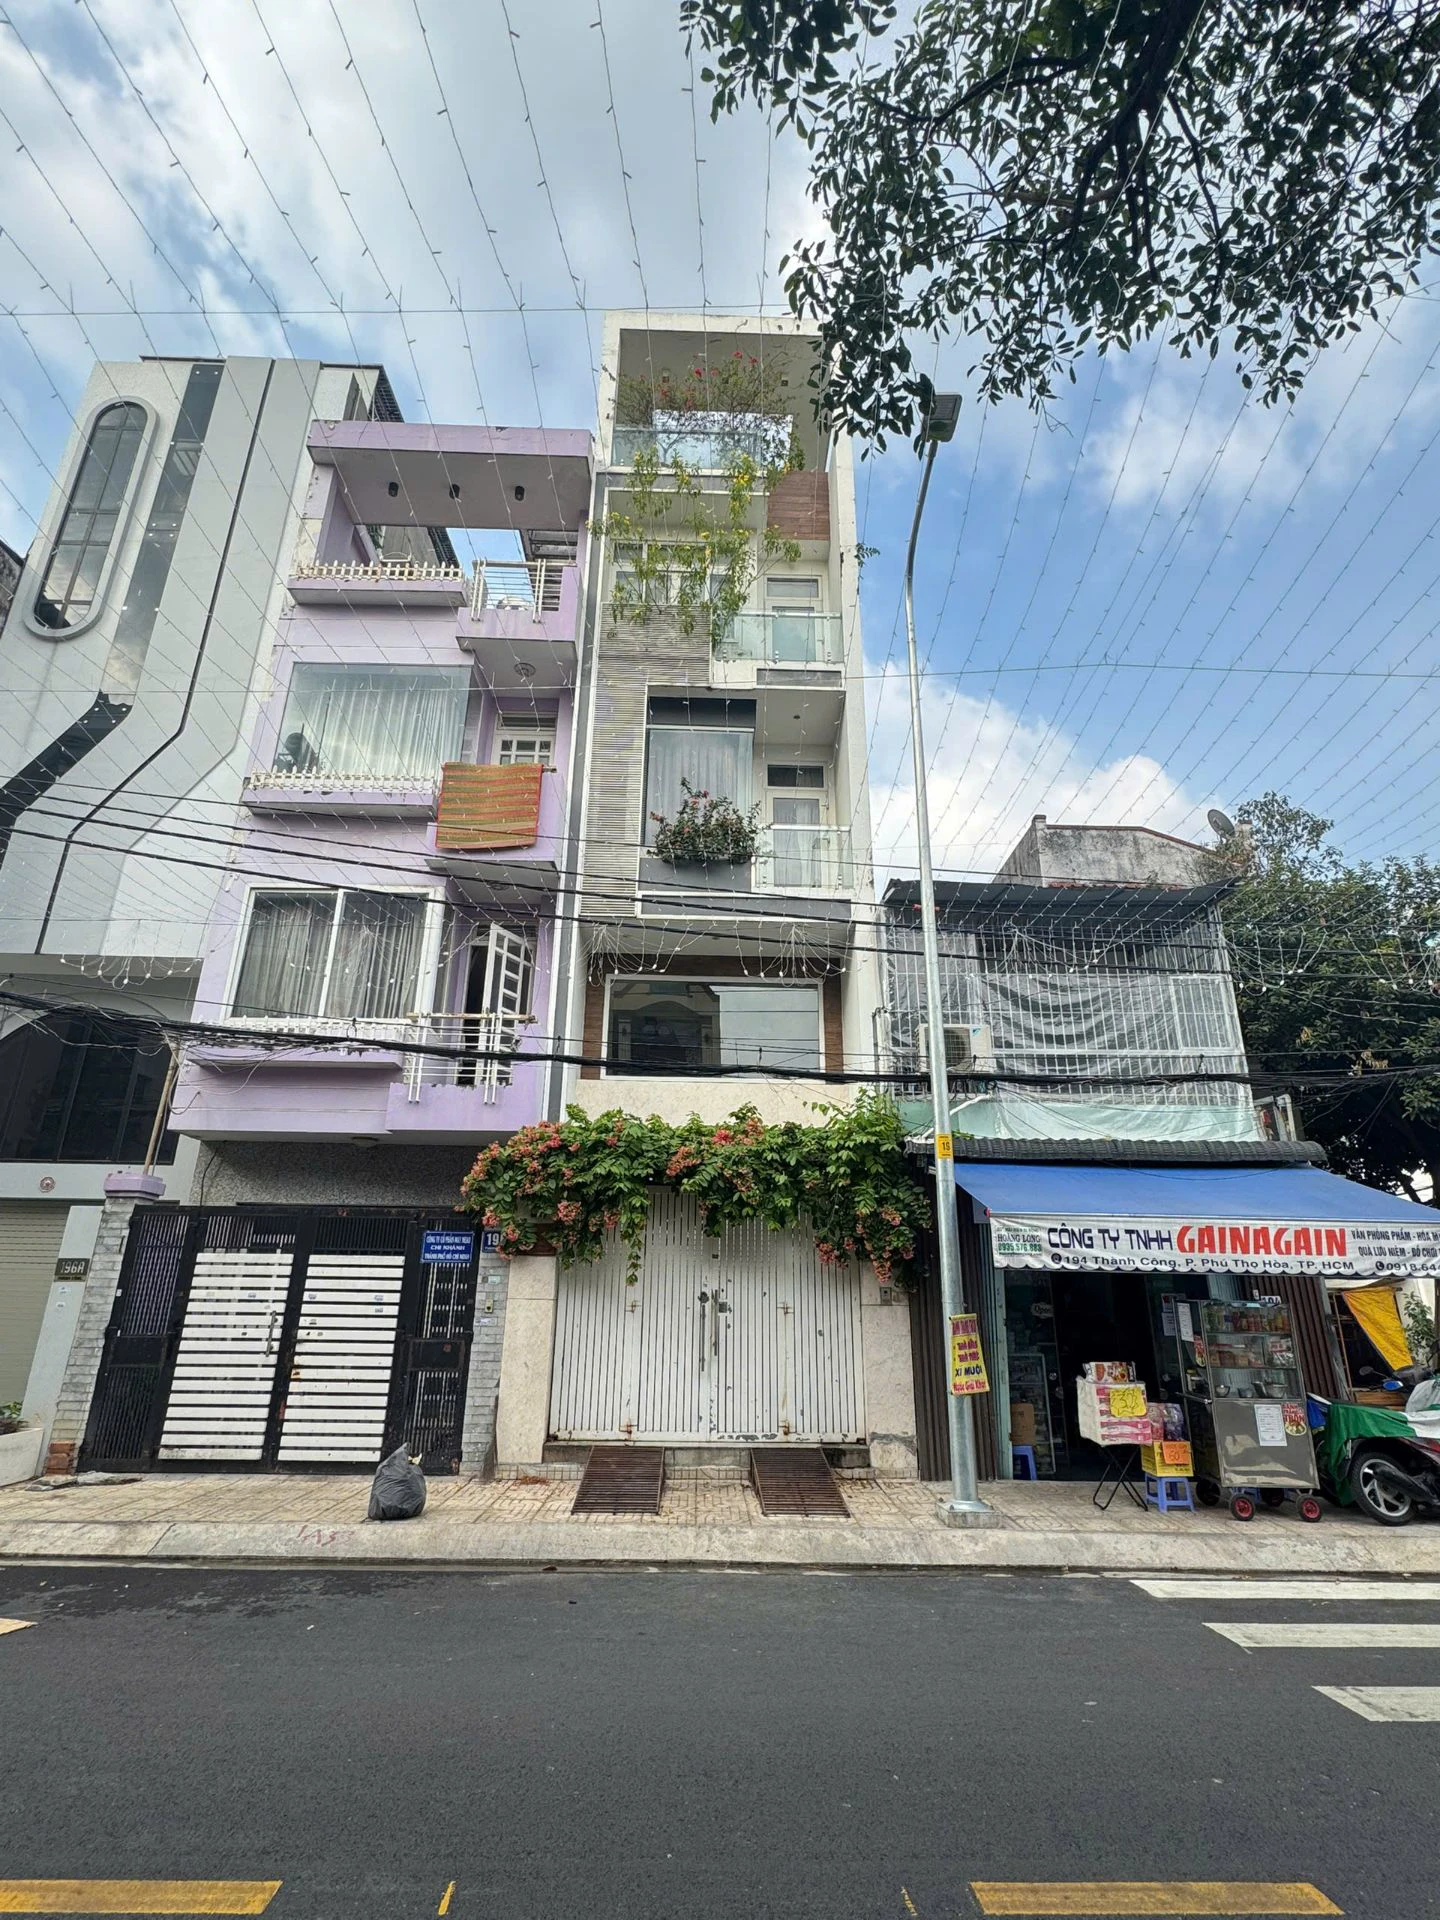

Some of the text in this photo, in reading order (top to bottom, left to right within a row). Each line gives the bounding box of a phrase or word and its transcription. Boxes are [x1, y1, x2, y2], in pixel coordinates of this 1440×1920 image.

[1048, 1223, 1347, 1257] CÔNG TY TNHH GAINAGAIN
[60, 1261, 85, 1273] 196A
[1064, 1256, 1088, 1265] 194
[1093, 1256, 1136, 1266] Thành
[1185, 1258, 1197, 1267] P.
[1201, 1256, 1228, 1267] Phú
[1232, 1259, 1259, 1269] Thọ
[1296, 1260, 1318, 1270] TP.
[1322, 1261, 1354, 1270] HCM
[1386, 1262, 1440, 1272] 0918.64
